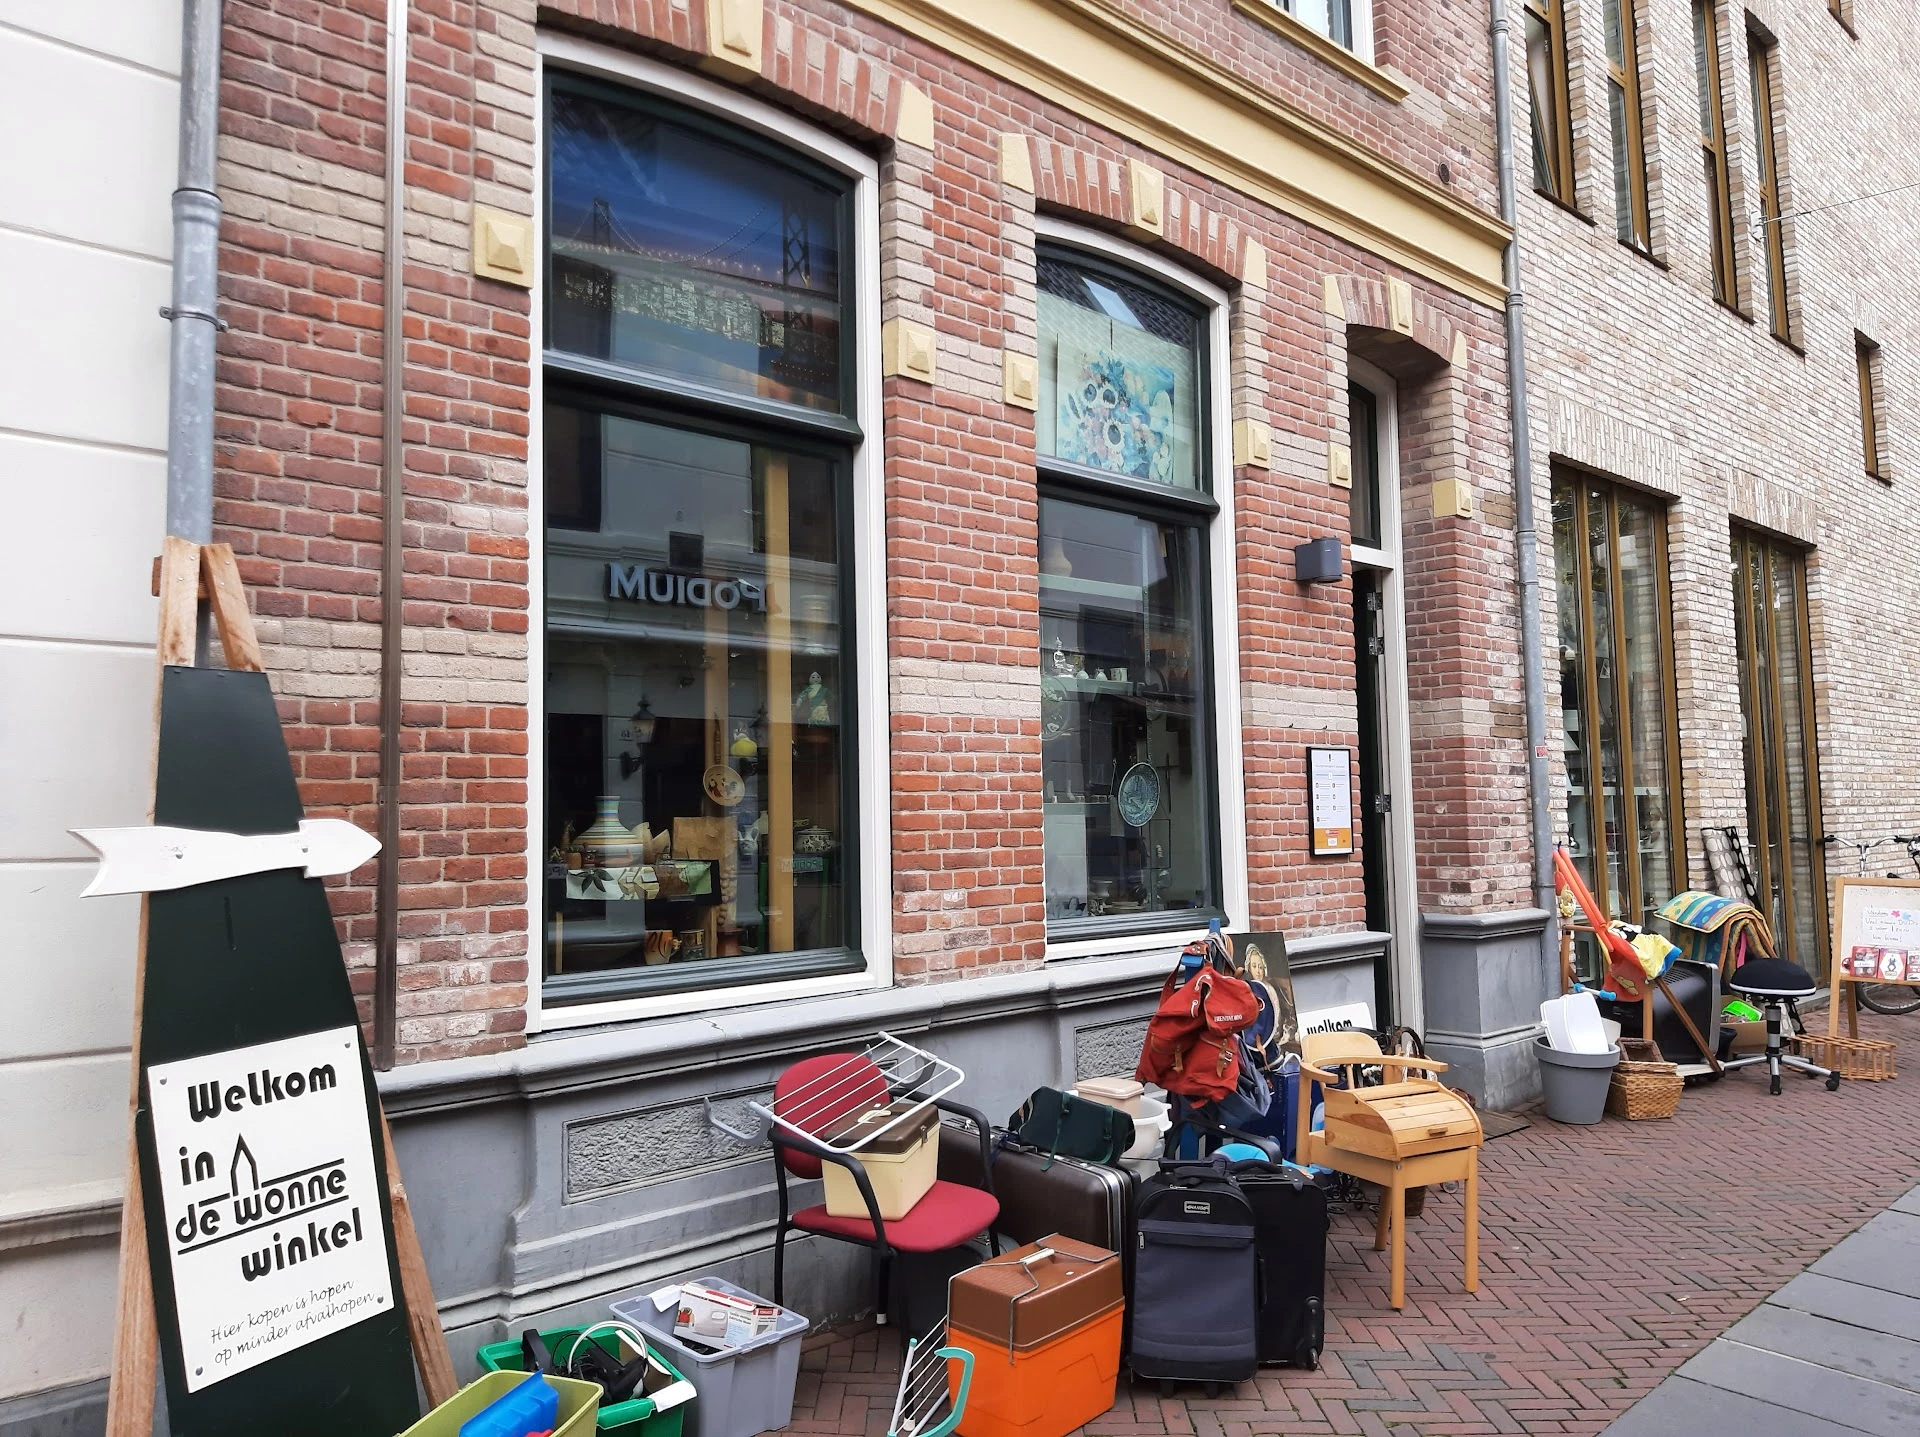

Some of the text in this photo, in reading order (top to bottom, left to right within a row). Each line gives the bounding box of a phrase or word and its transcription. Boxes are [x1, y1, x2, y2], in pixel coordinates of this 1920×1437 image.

[187, 1062, 337, 1123] Welkom
[178, 1146, 215, 1187] in
[175, 1167, 347, 1244] de wonne
[241, 1206, 364, 1282] winkel
[211, 1279, 356, 1345] Hier kopen is hopen
[214, 1292, 376, 1365] op minder afvalhopen
